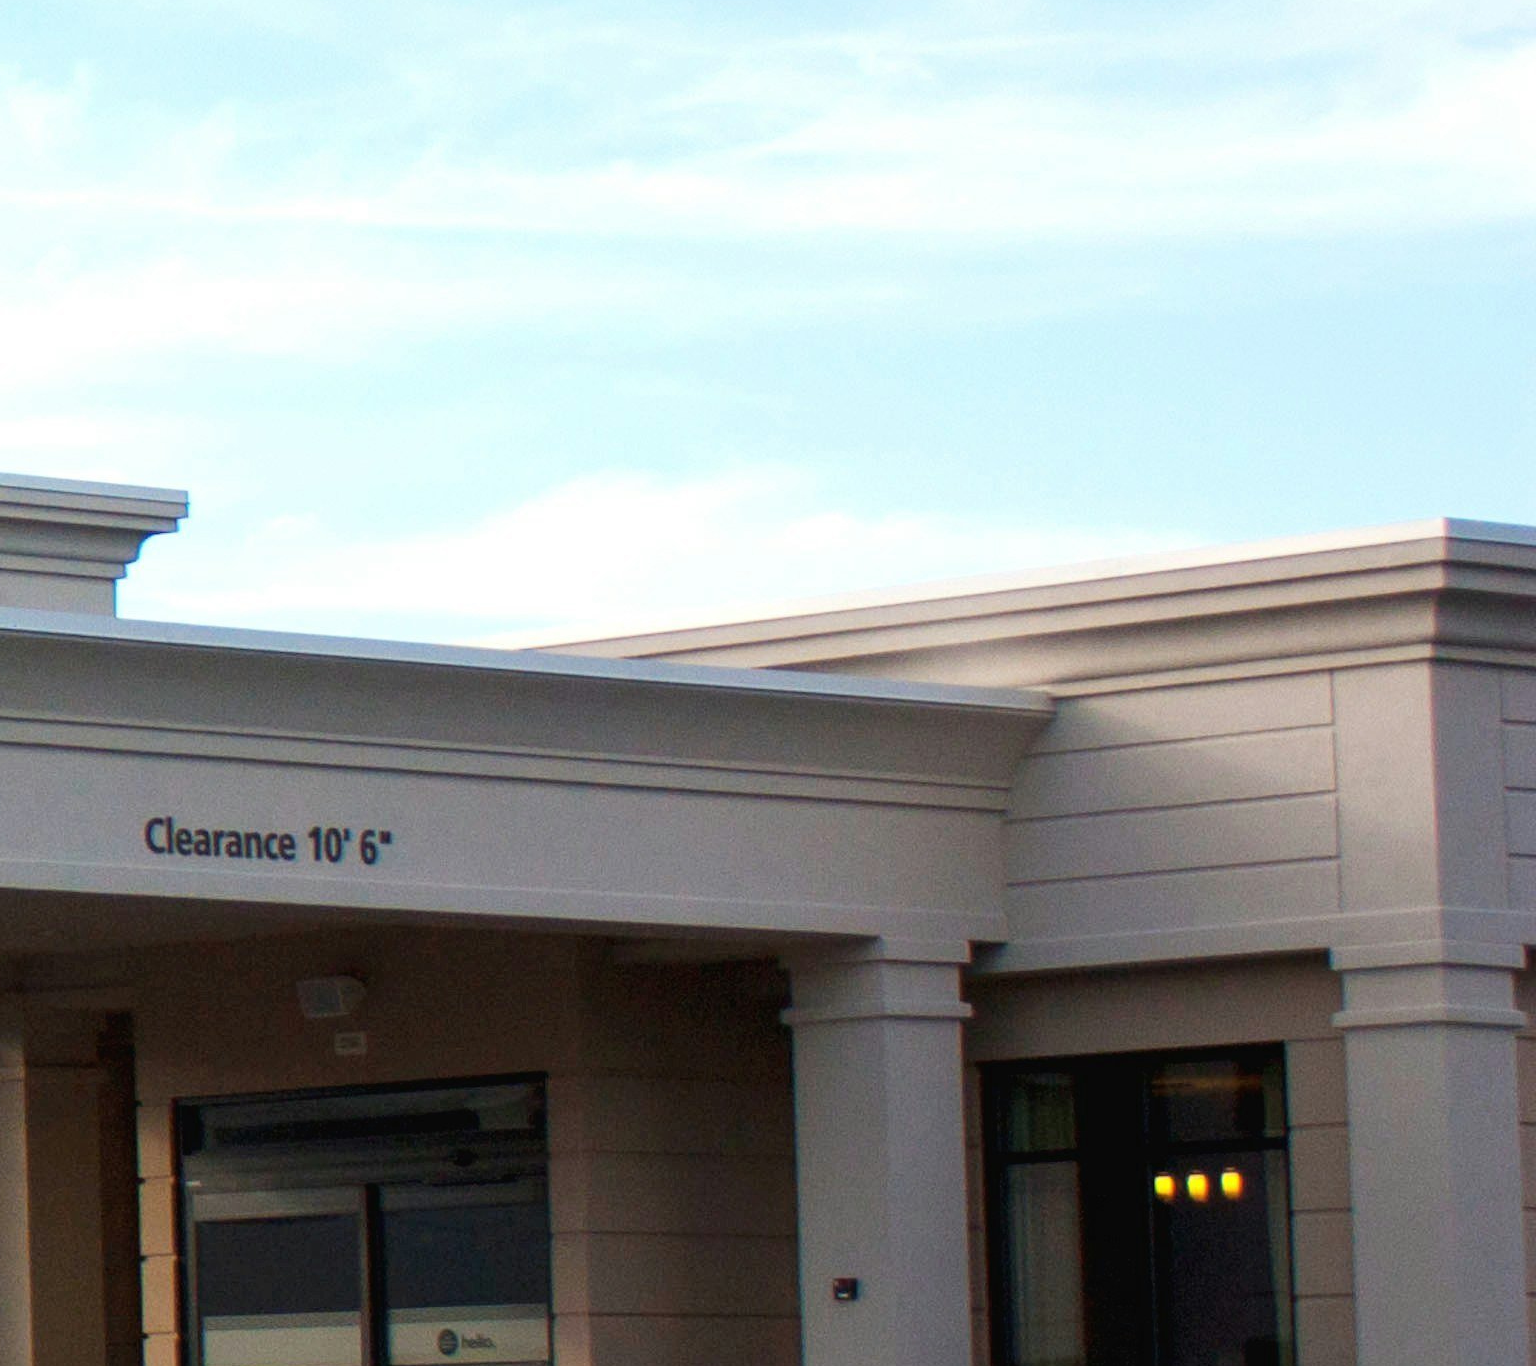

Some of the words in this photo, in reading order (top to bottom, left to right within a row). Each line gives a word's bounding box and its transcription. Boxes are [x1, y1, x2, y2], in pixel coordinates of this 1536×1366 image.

[144, 817, 296, 861] Clearance
[308, 826, 350, 863] 10'
[359, 829, 392, 866] 6"
